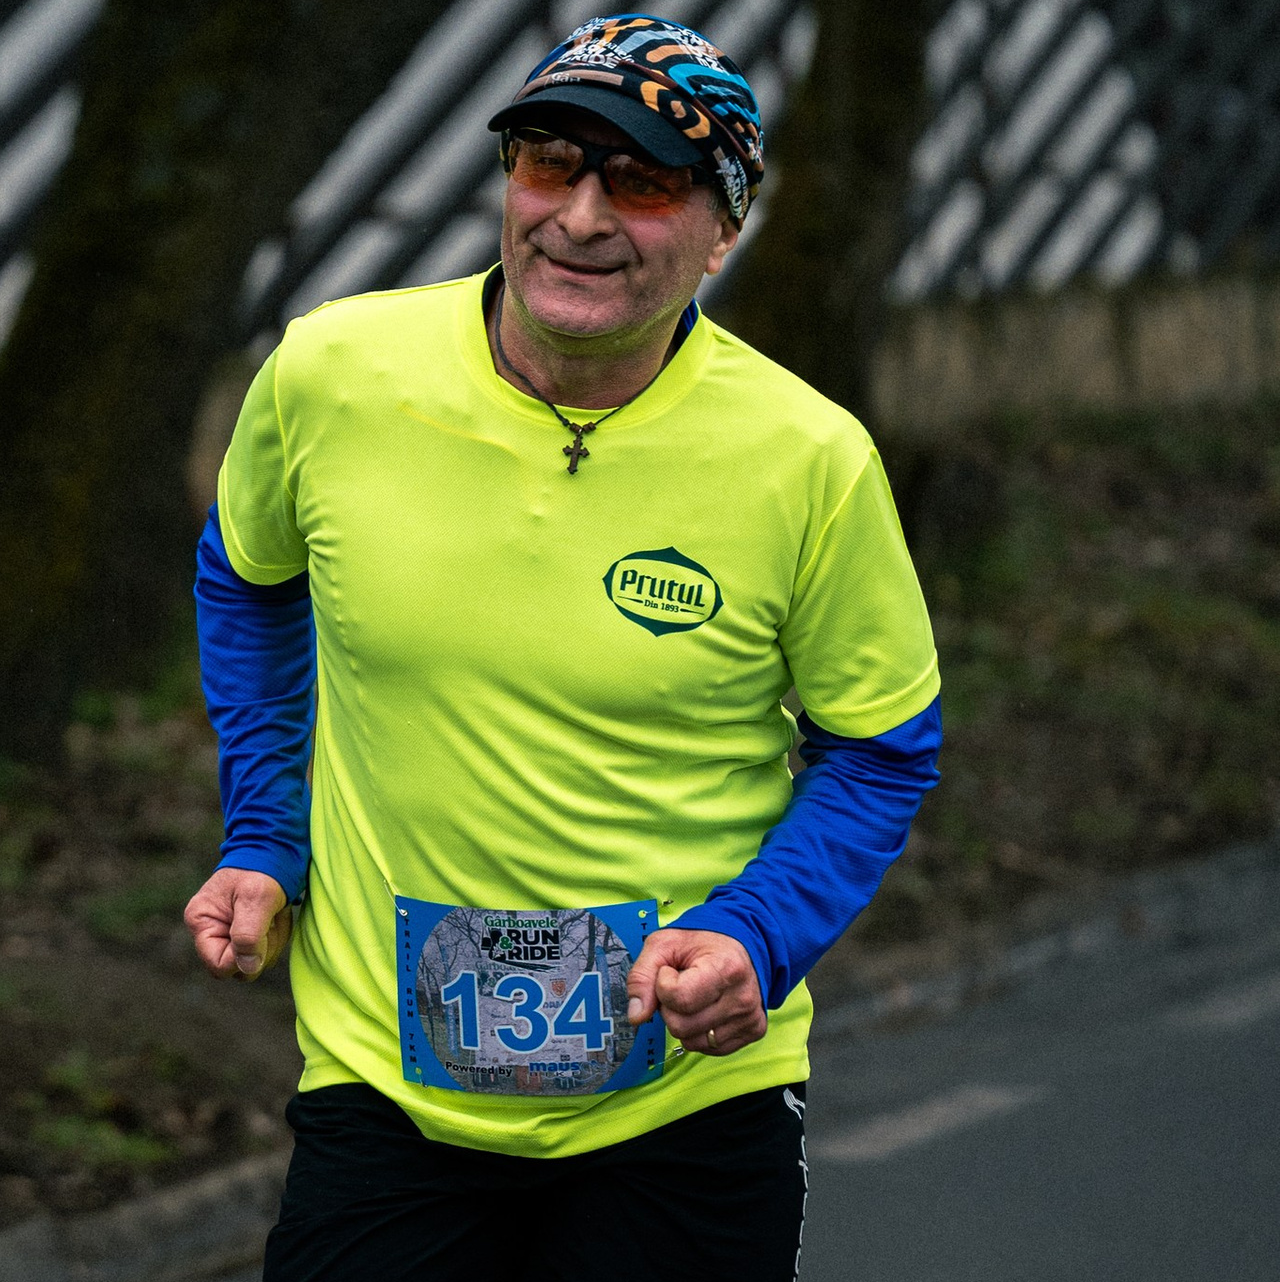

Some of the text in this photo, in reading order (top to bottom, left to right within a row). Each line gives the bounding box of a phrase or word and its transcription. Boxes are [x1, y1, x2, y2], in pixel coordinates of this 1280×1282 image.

[644, 599, 680, 613] Din 1893
[507, 929, 560, 945] RUN
[508, 946, 561, 960] RIDE
[441, 971, 613, 1053] 134
[446, 1061, 513, 1077] Powered by
[529, 1061, 580, 1072] maus
